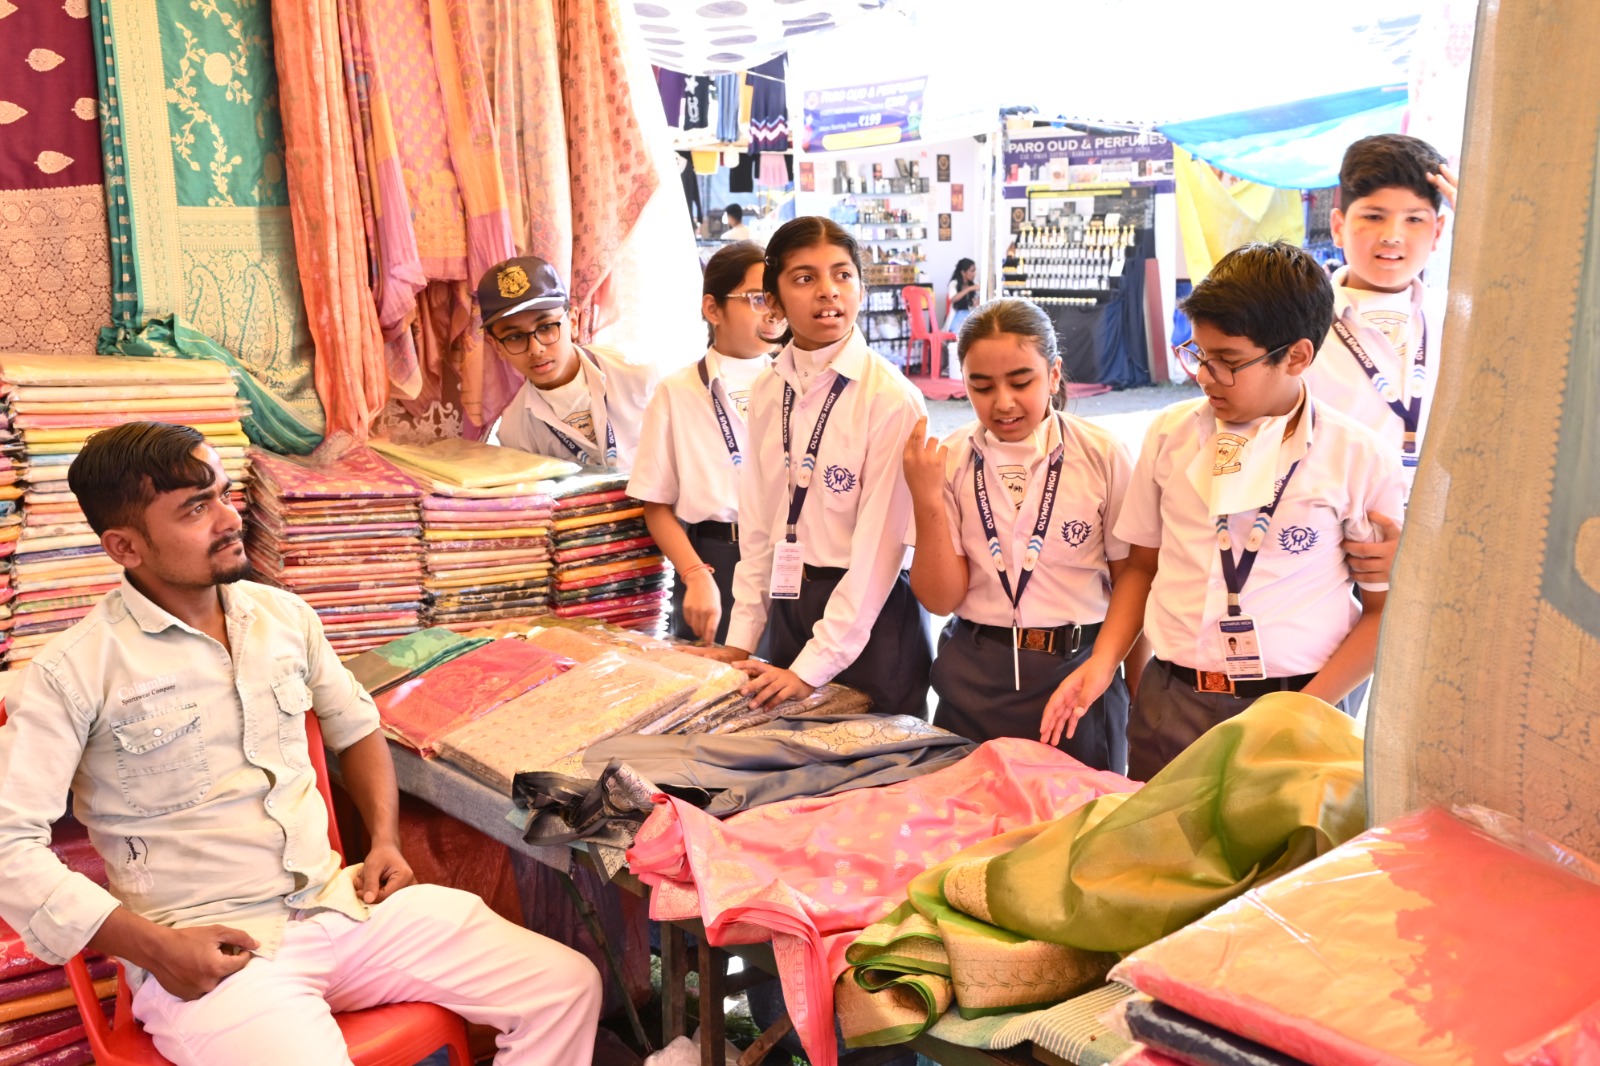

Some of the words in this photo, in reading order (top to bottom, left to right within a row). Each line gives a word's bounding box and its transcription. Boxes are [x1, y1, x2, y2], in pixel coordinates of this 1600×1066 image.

[1008, 141, 1045, 154] PARO
[1047, 139, 1079, 152] OUD
[1080, 138, 1092, 150] &
[1346, 337, 1373, 369] OLYMPUS
[714, 398, 724, 416] HIGH
[784, 385, 792, 405] HIGH
[719, 415, 735, 448] OLYMPUS
[810, 411, 827, 450] OLYMPUS
[822, 393, 837, 412] HIGH
[976, 470, 984, 490] HIGH
[978, 490, 994, 529] OLYMPUS
[1037, 491, 1052, 531] OLYMPUS
[1047, 470, 1058, 491] HIGH
[118, 673, 177, 698] Columbia
[121, 692, 151, 706] Sportswear
[151, 684, 176, 696] Company
